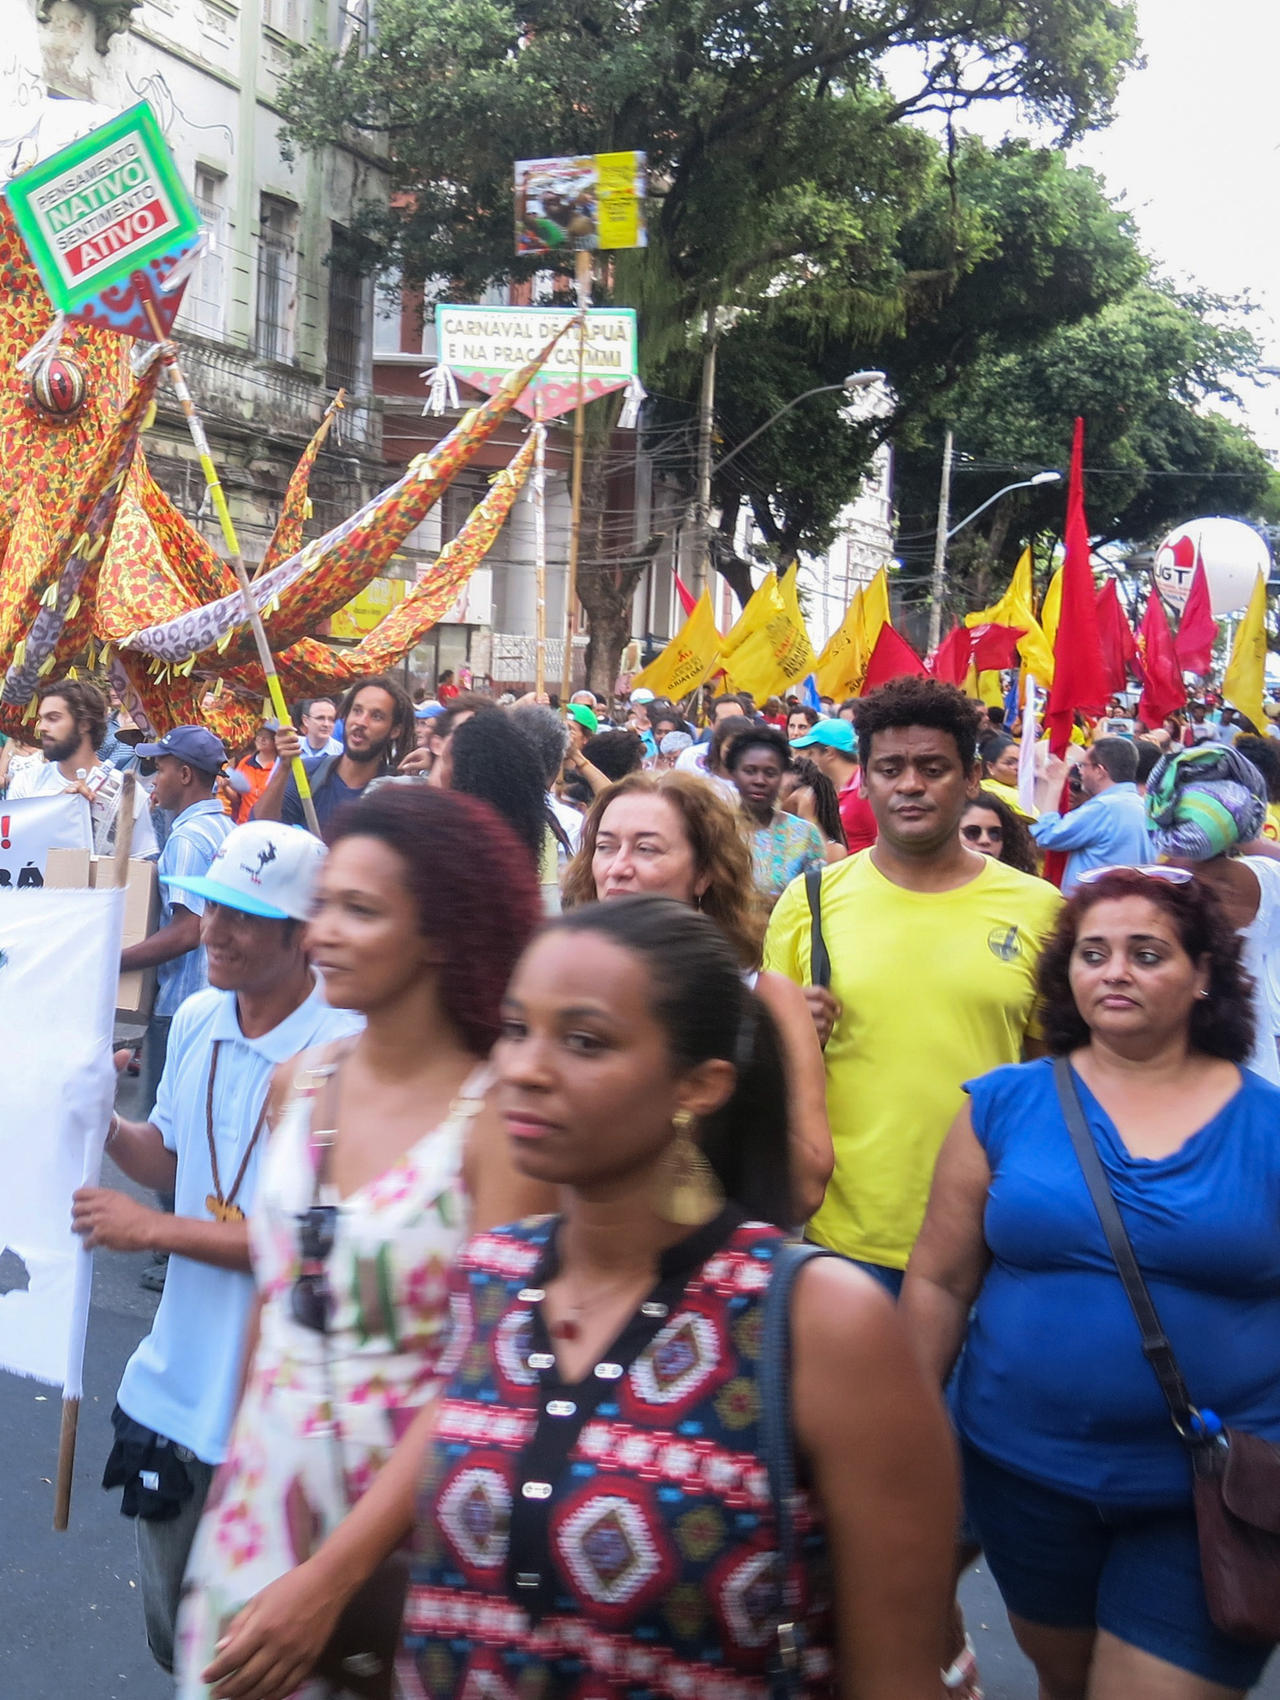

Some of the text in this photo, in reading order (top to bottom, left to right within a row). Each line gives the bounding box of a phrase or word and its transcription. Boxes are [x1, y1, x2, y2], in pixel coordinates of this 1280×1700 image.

[37, 143, 137, 209] PENSAMENTO
[47, 162, 146, 231] NATIVO
[55, 184, 156, 251] SENTIMENTO
[79, 209, 156, 269] ATIVO
[444, 319, 533, 339] CARNAVAL
[463, 344, 488, 361] NA
